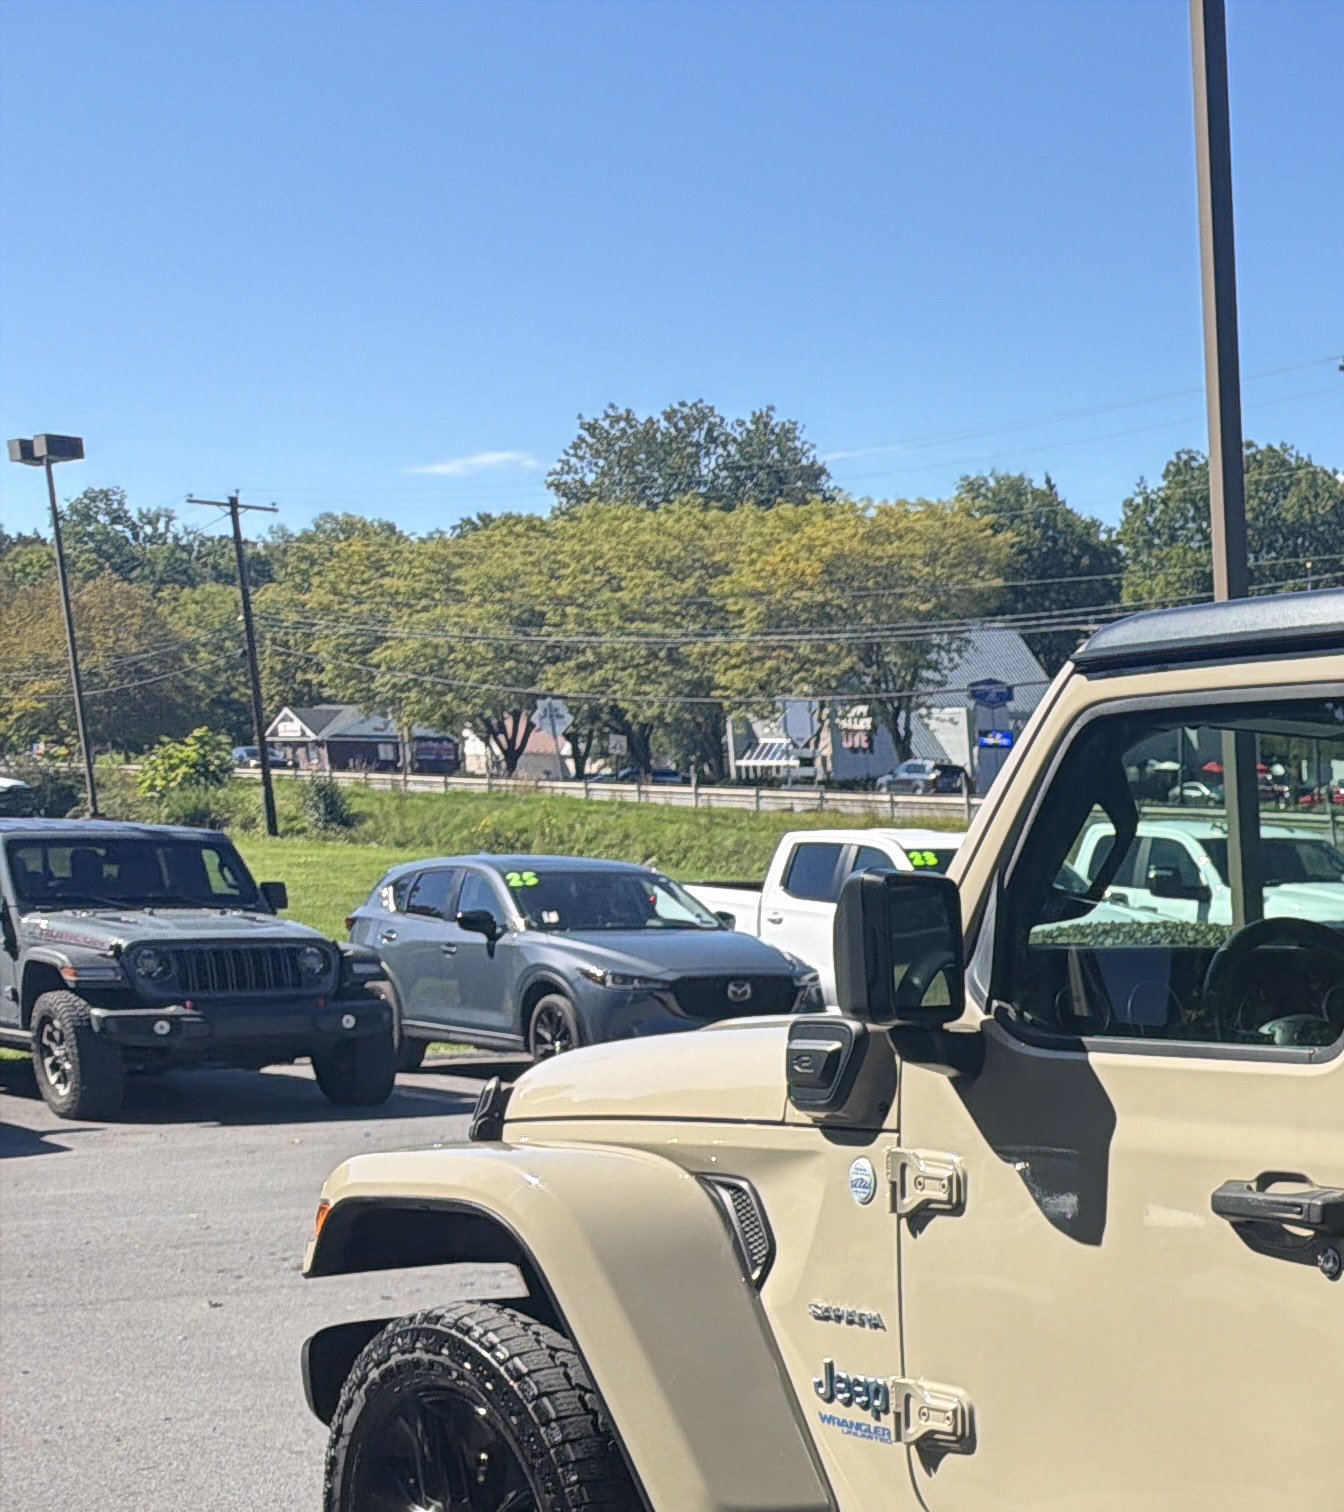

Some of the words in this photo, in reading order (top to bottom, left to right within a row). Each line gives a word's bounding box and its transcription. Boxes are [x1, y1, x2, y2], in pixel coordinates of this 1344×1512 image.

[908, 851, 938, 866] 23
[505, 871, 539, 887] 25
[808, 1303, 887, 1331] SAHARA
[812, 1358, 890, 1422] Jeep
[818, 1411, 891, 1440] WRANGLER
